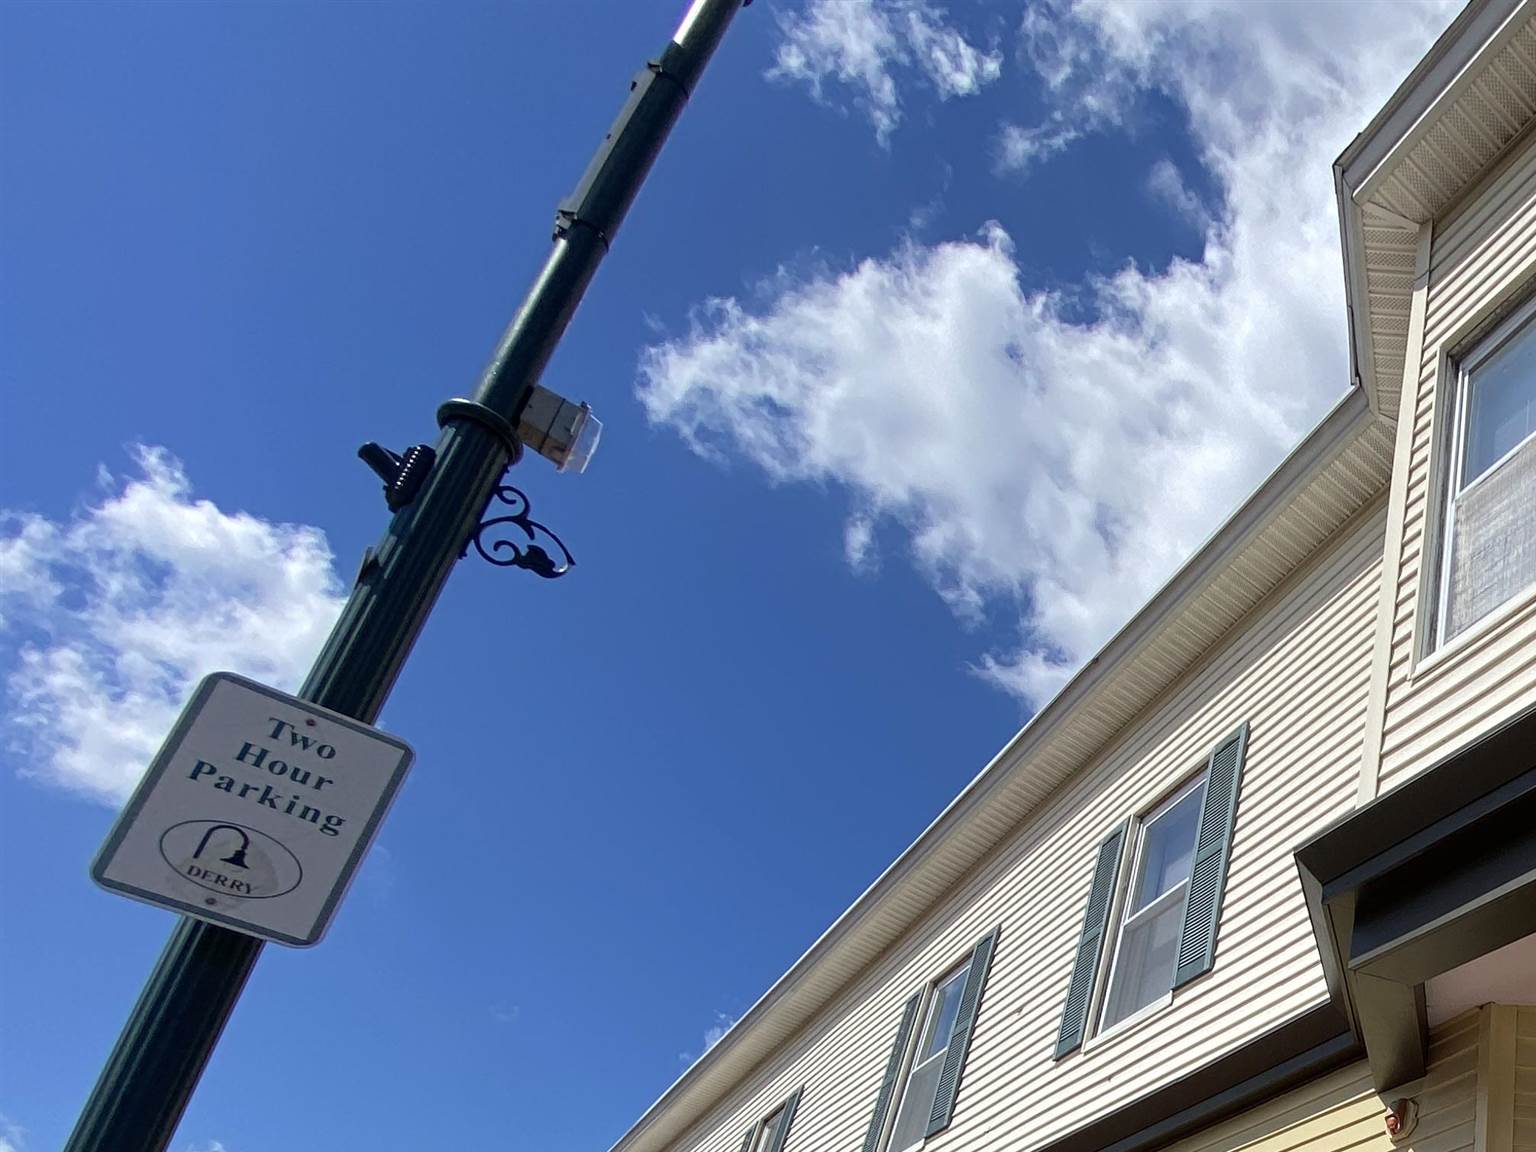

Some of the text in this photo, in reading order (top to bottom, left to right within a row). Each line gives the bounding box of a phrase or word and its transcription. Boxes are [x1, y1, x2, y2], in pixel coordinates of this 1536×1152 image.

[268, 716, 337, 760] Two
[235, 741, 334, 791] Hour
[186, 759, 347, 837] Parking
[187, 865, 255, 894] DERRY
